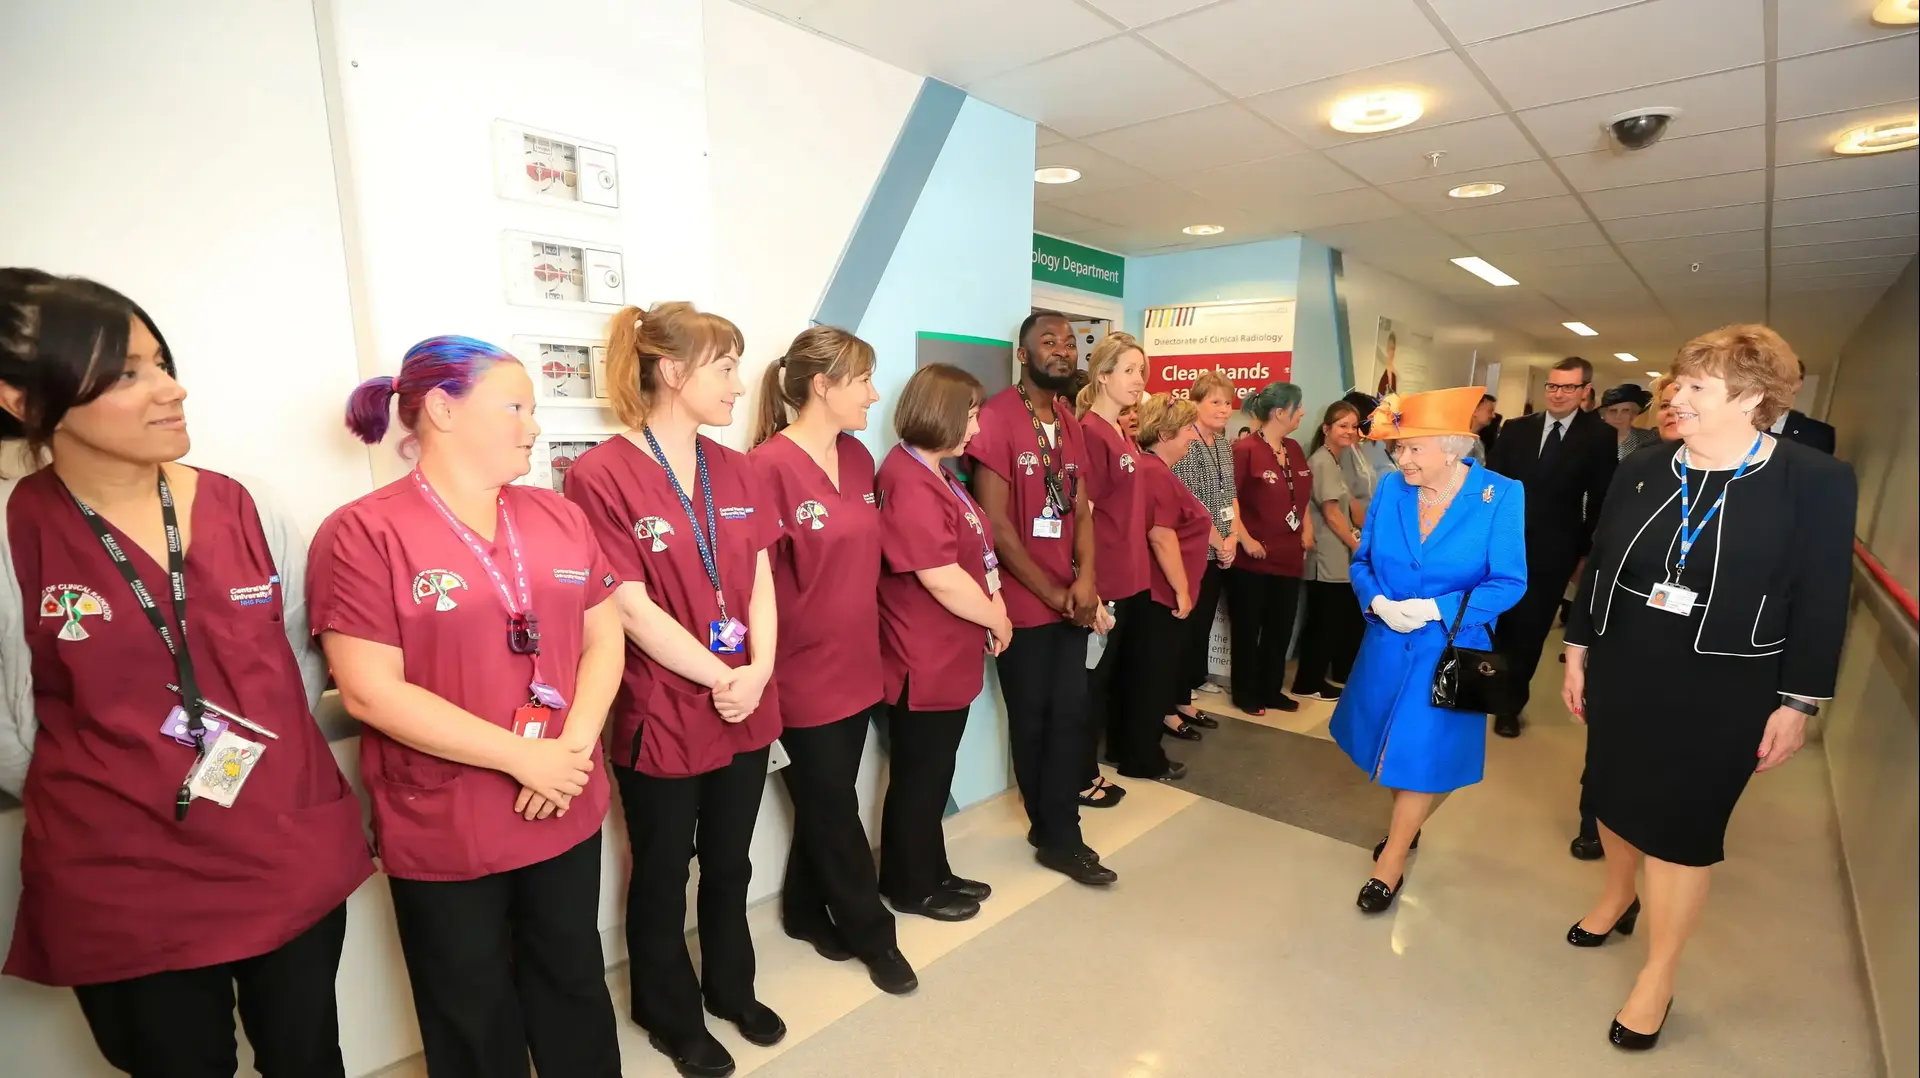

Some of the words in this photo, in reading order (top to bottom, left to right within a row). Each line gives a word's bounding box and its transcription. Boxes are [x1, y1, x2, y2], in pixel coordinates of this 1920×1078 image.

[1032, 247, 1061, 272] ology
[1062, 255, 1120, 284] Department
[1154, 337, 1197, 346] Directorate
[1199, 335, 1208, 344] of
[1209, 334, 1239, 344] Clinical
[1240, 333, 1283, 343] Radiology
[1162, 364, 1209, 381] Clean
[1172, 387, 1191, 400] sa
[166, 525, 178, 553] FUJIFILM
[103, 533, 128, 562] FUJIFILM
[45, 584, 57, 593] OF
[134, 579, 156, 608] FUJIFILM
[171, 572, 183, 601] FUJIFILM
[230, 586, 259, 595] Central
[1214, 633, 1228, 644] the
[1211, 645, 1231, 656] entr
